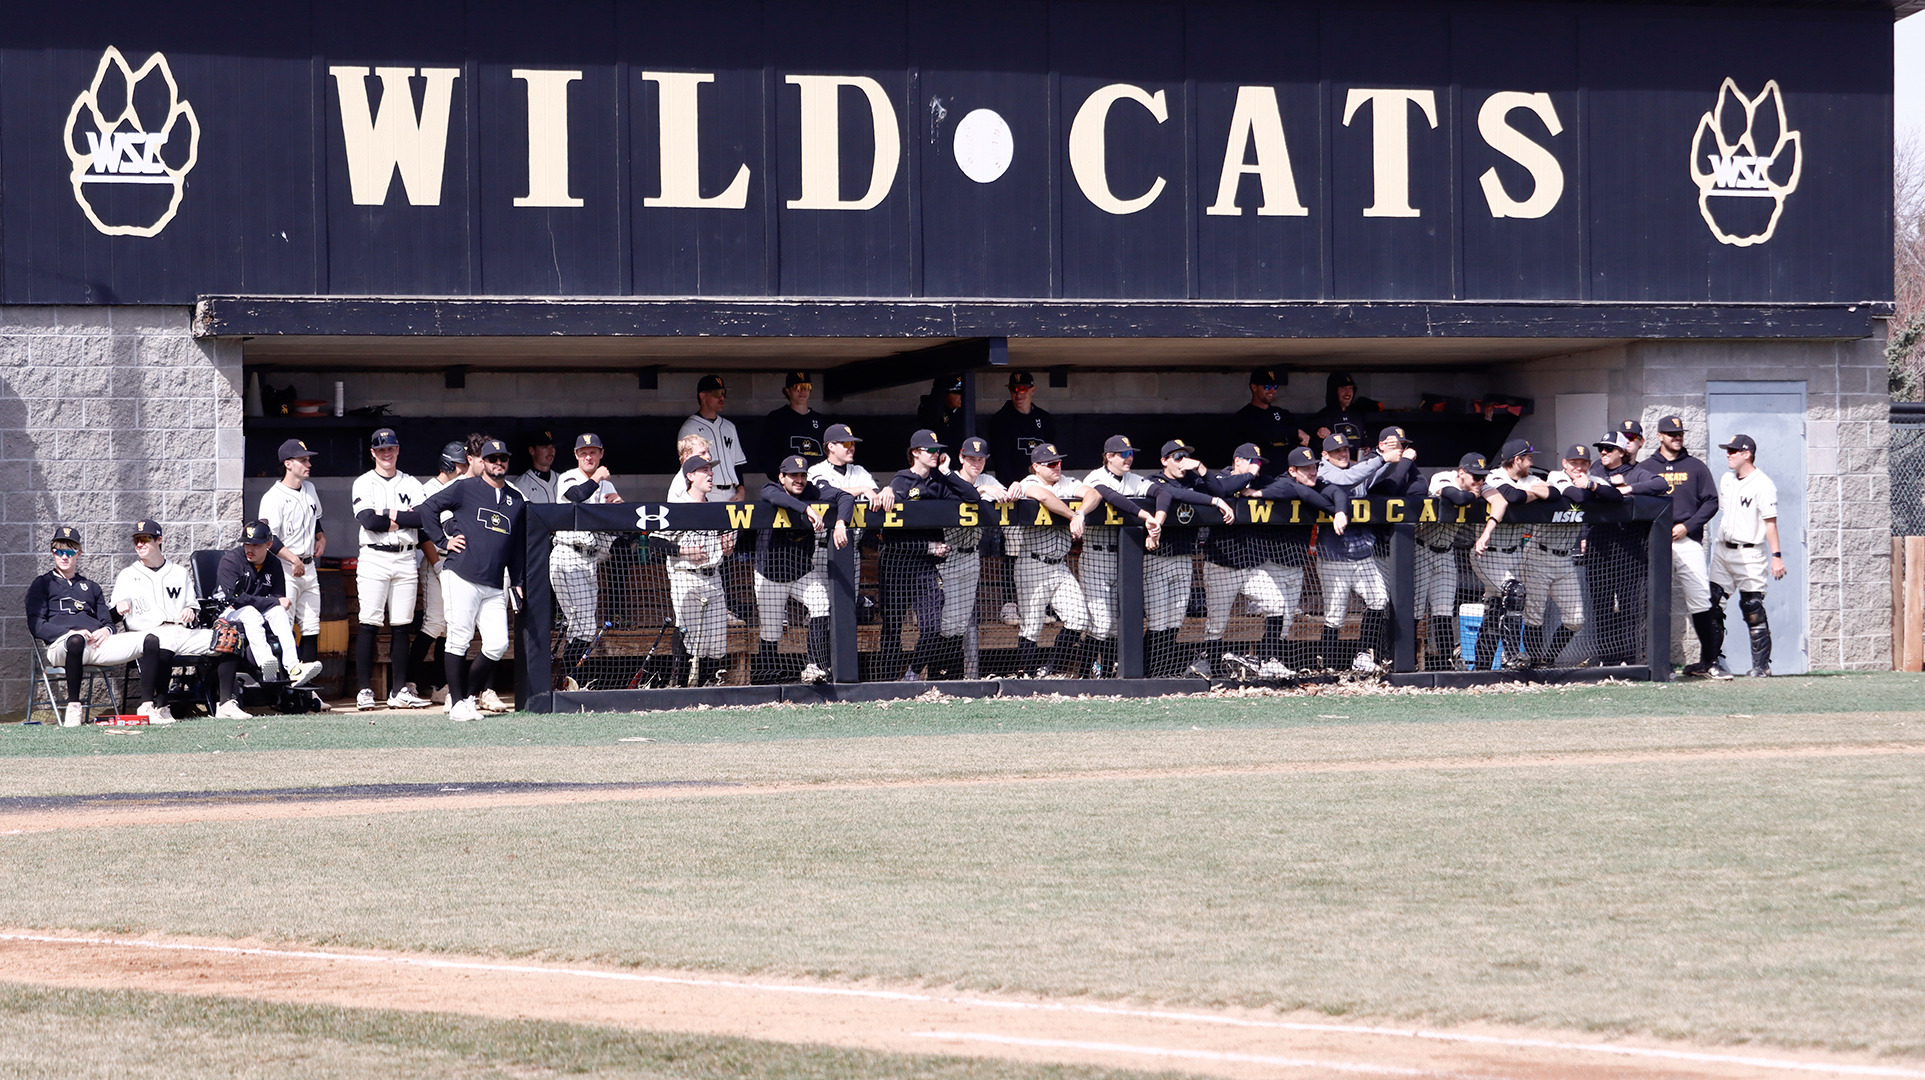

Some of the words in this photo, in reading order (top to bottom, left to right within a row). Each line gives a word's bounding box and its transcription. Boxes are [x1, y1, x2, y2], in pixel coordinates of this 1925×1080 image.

[85, 132, 169, 173] WSC
[330, 67, 900, 209] WILD
[1069, 84, 1563, 218] CATS
[1708, 155, 1775, 188] WSC
[1247, 499, 1502, 523] WILDCAT
[1741, 496, 1753, 508] W
[1551, 511, 1585, 523] NSIC
[166, 587, 182, 599] W
